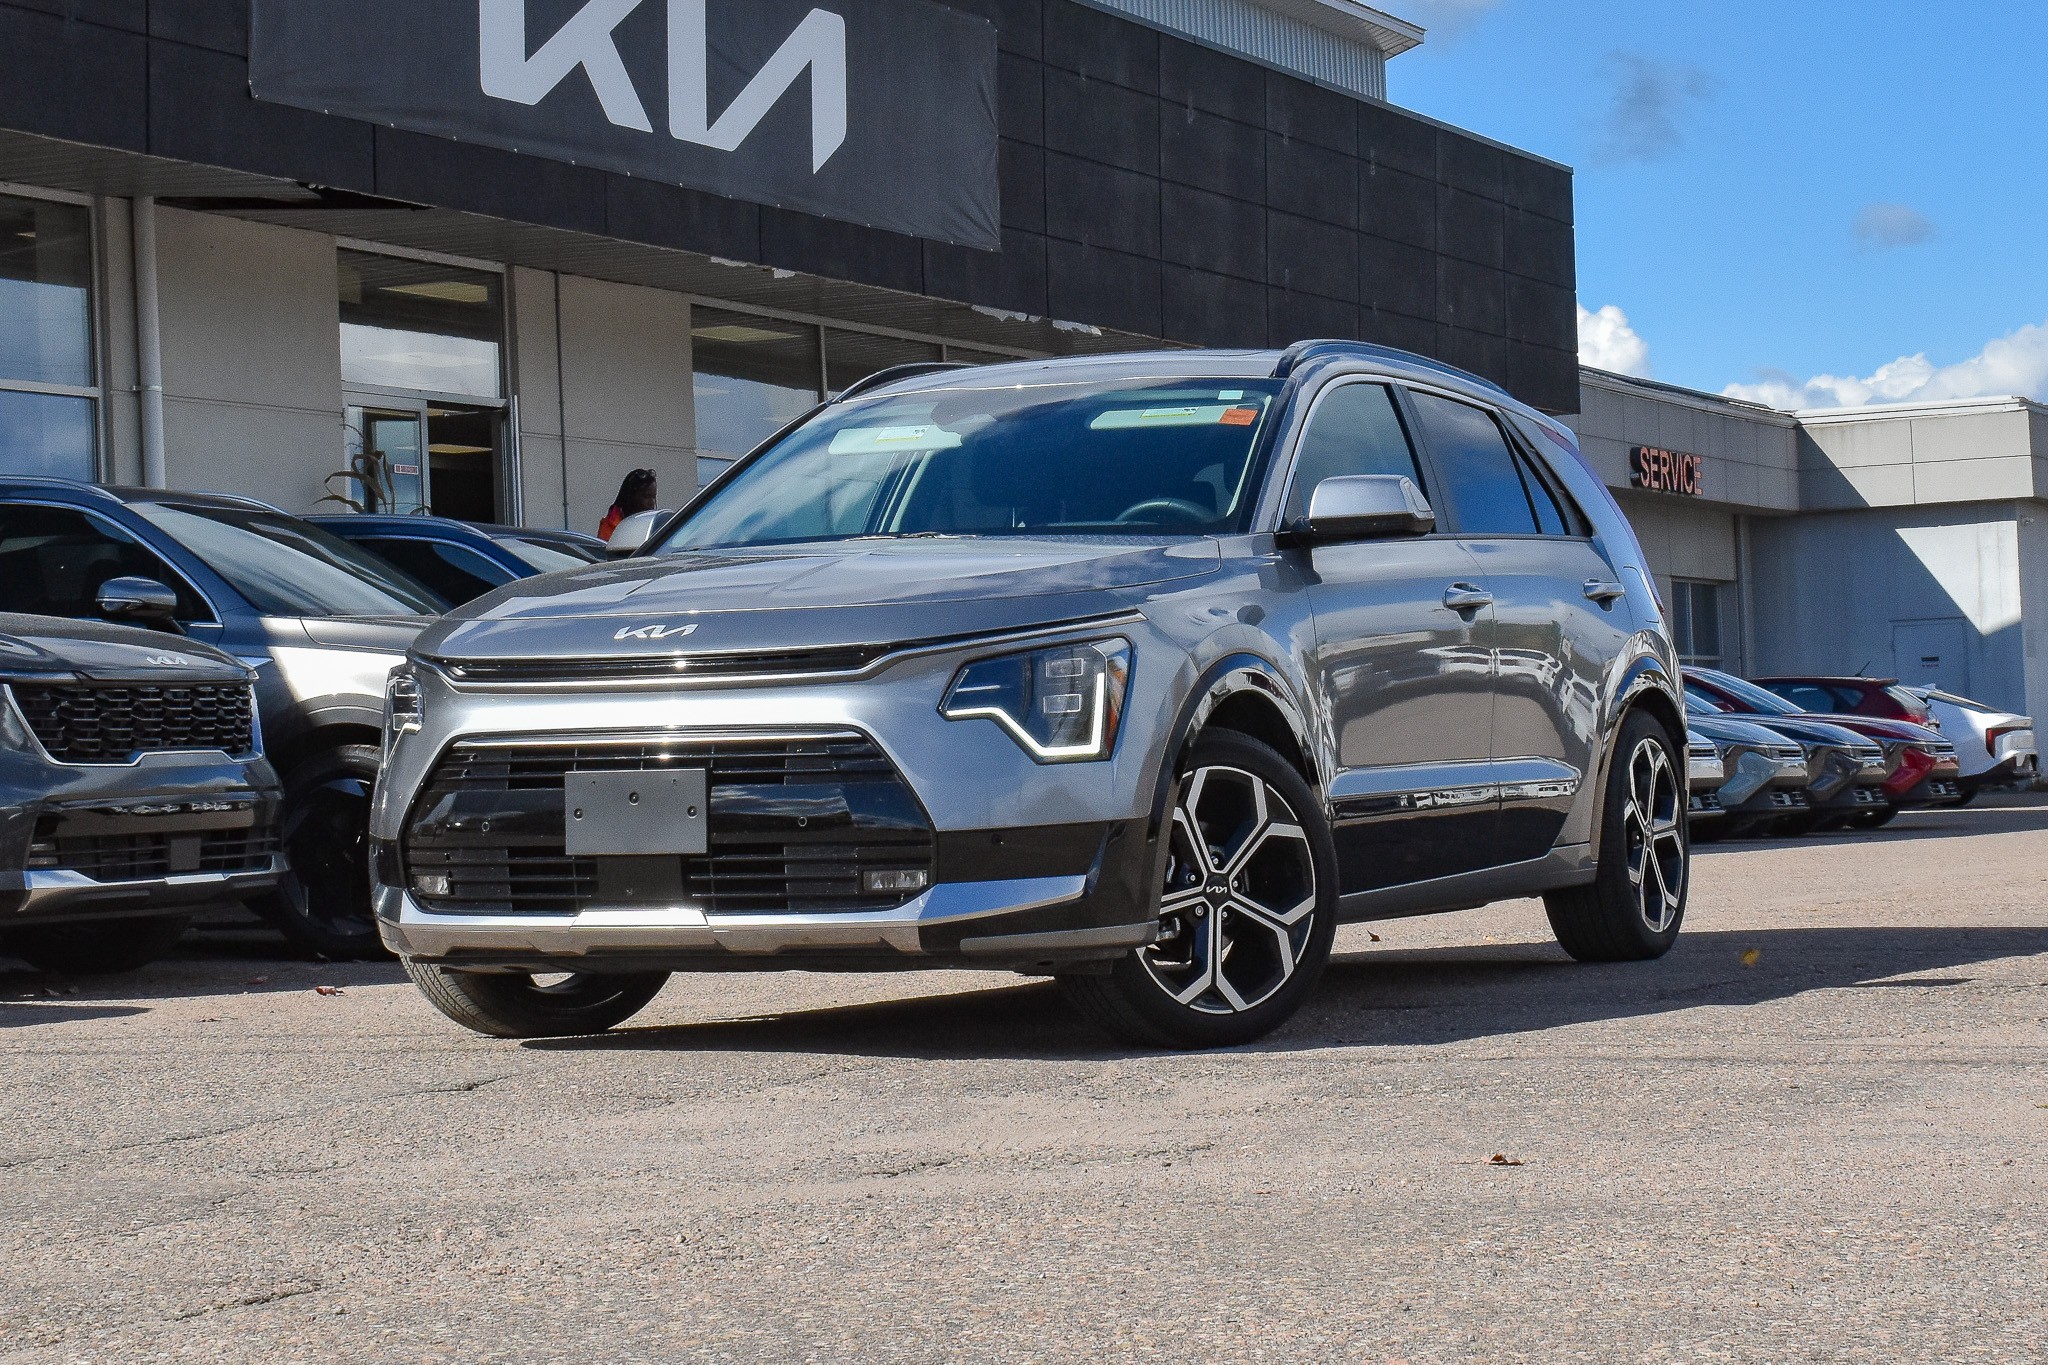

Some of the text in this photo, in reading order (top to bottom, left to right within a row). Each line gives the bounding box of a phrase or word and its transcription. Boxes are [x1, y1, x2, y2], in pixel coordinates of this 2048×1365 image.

[479, 0, 847, 174] KIA
[1641, 446, 1703, 495] SERVICE
[614, 624, 699, 640] KIA
